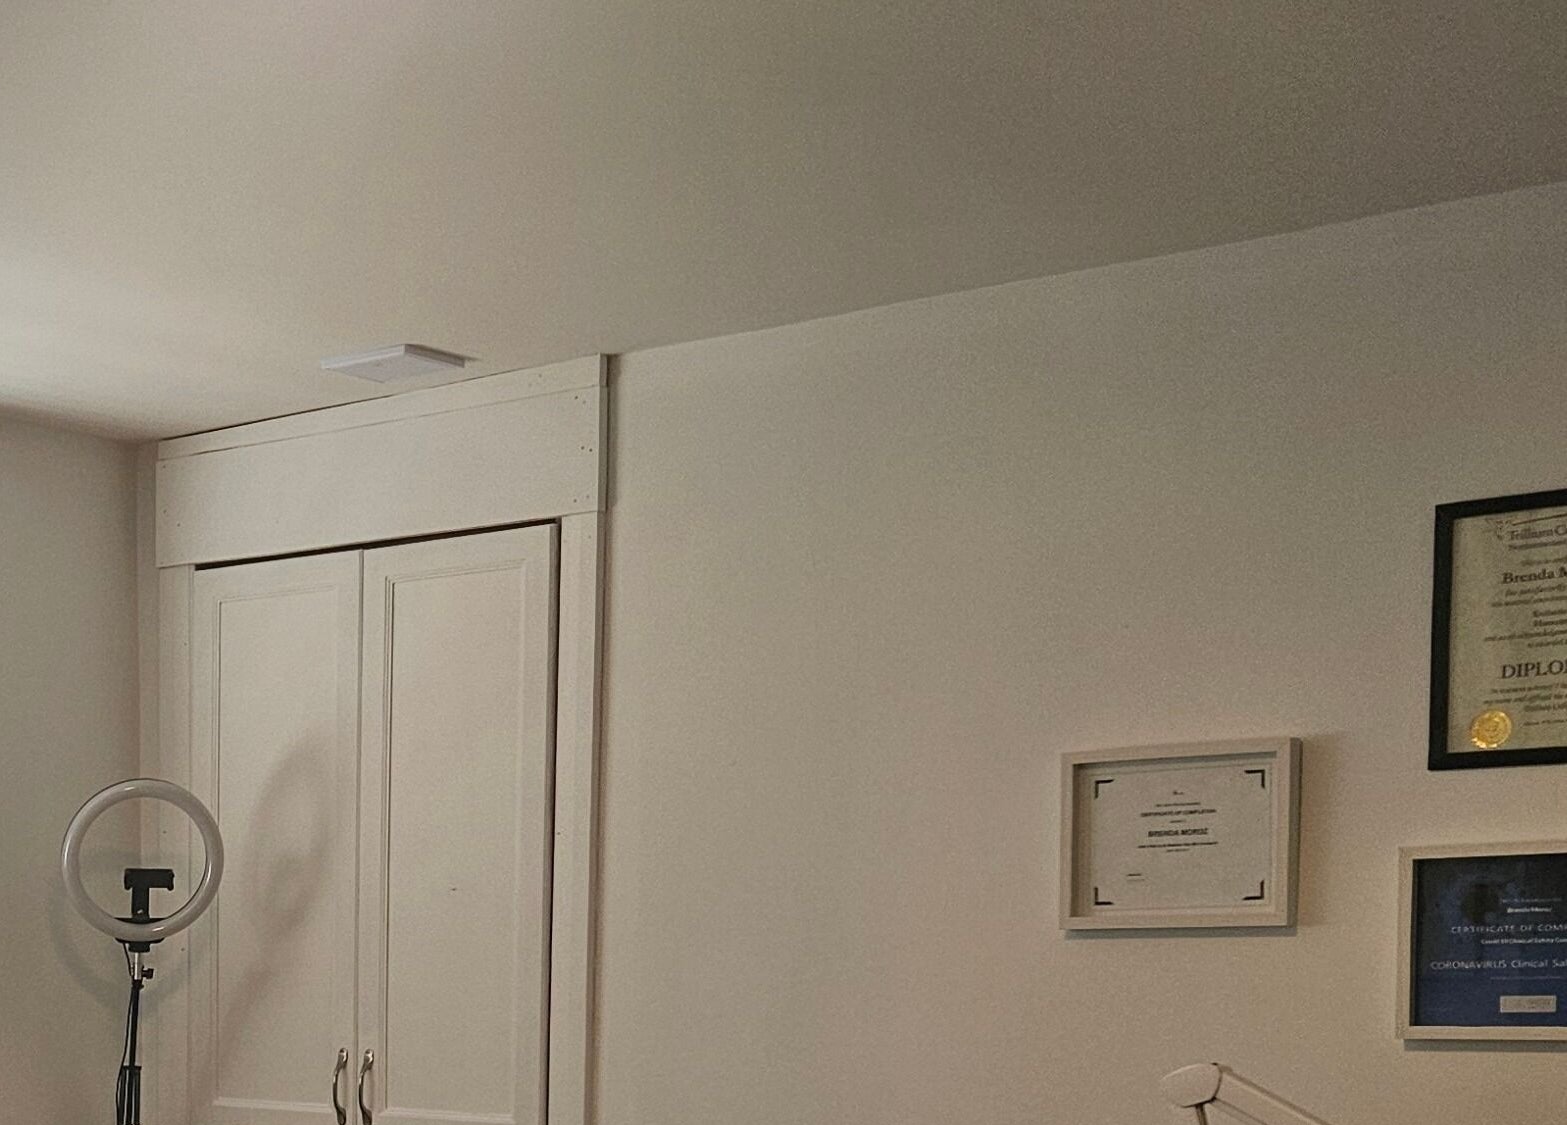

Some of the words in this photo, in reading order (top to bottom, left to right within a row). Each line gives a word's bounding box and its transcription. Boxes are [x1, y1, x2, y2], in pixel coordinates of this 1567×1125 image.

[1502, 567, 1554, 585] Brenda
[1501, 658, 1567, 679] DIPLO
[1451, 923, 1514, 934] CERTIFICATE
[1431, 959, 1507, 970] CORONAVIRUS
[1511, 958, 1549, 969] Clinical
